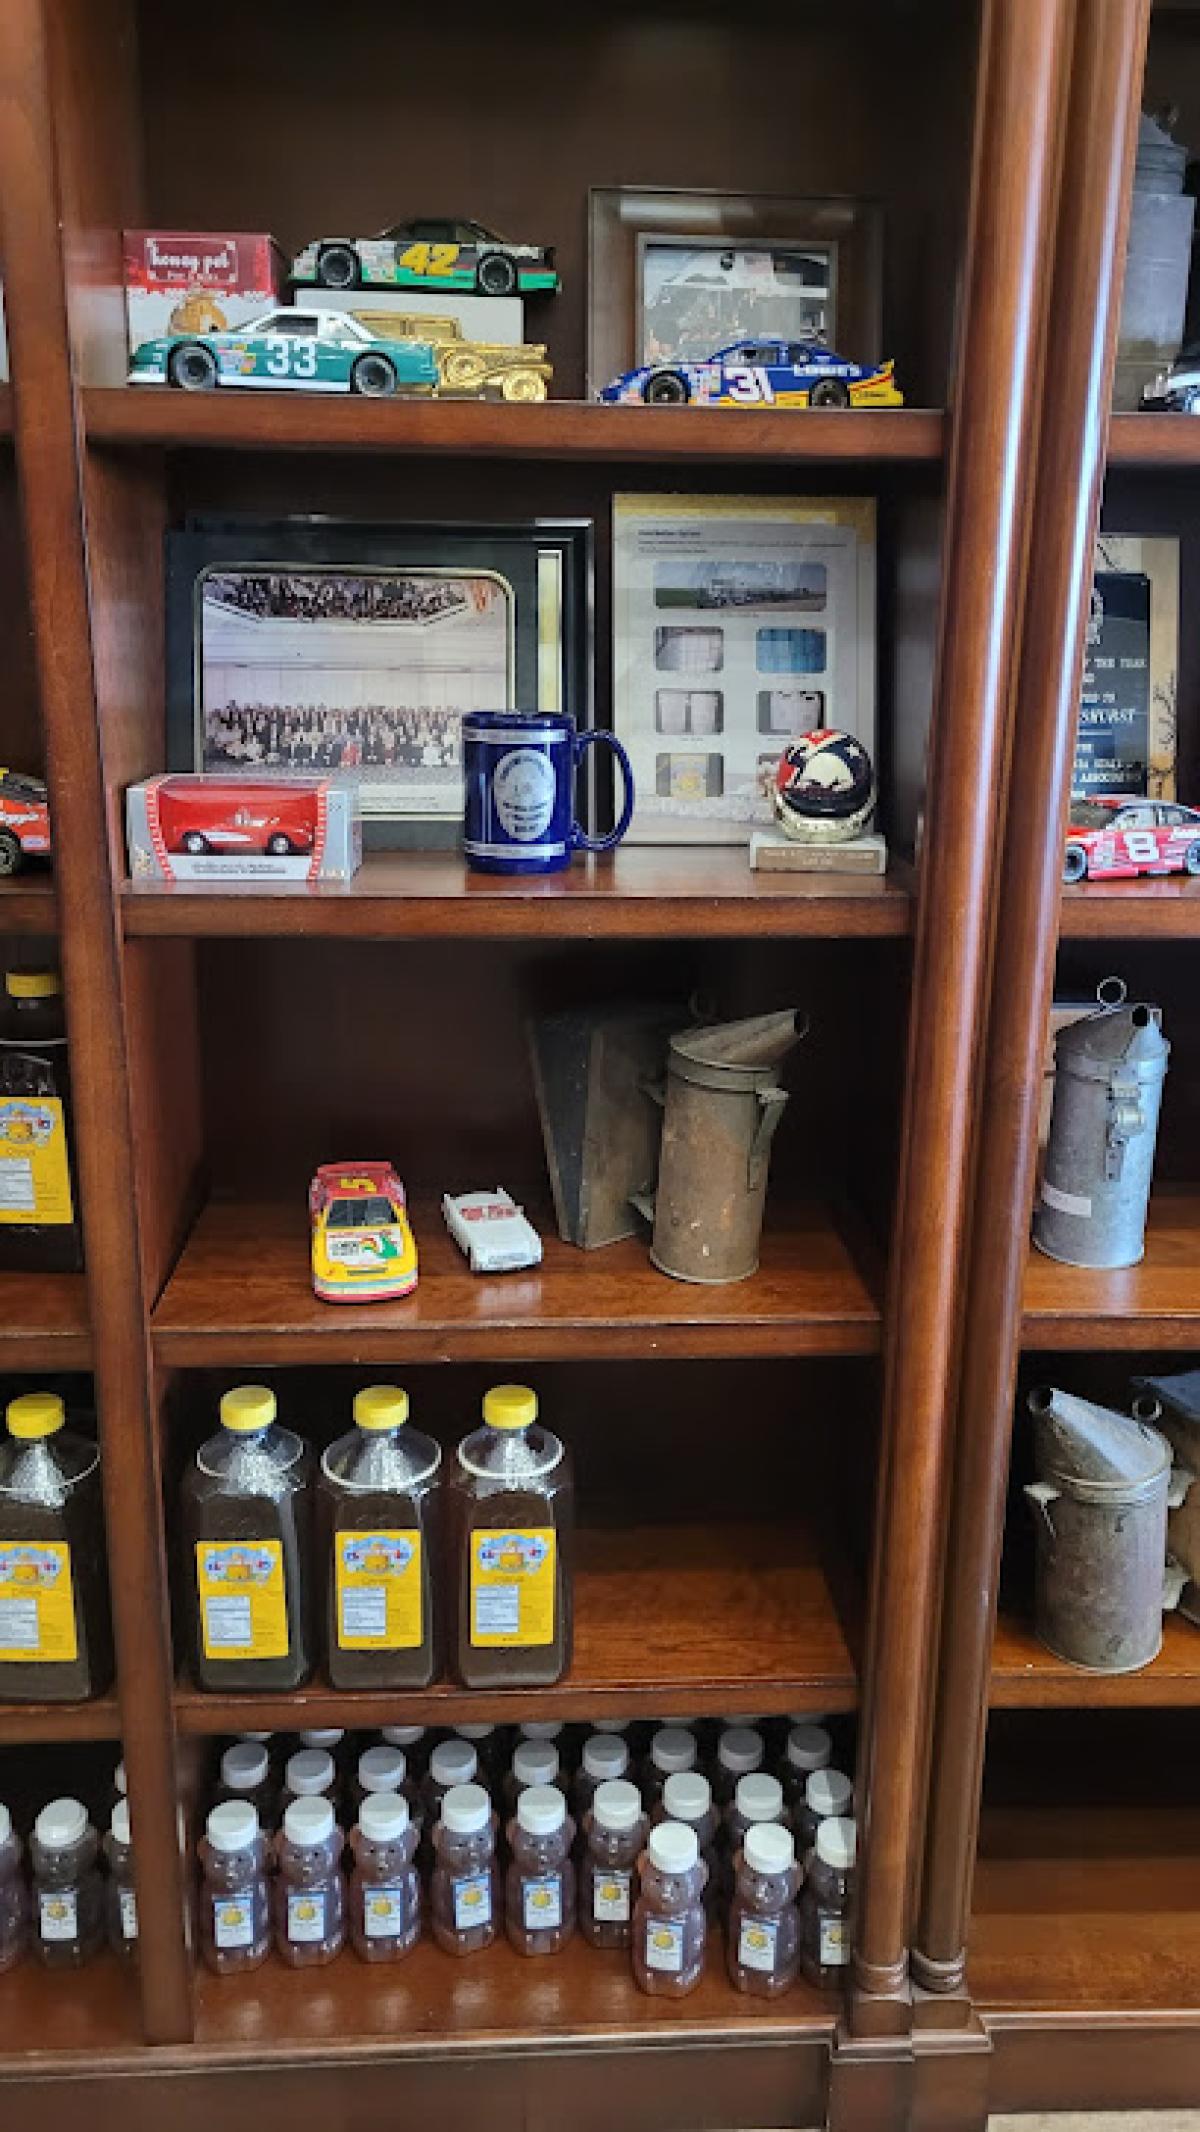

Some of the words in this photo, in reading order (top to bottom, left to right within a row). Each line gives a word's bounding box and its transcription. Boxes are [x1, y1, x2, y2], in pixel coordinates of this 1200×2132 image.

[399, 243, 459, 276] 42
[265, 338, 316, 376] 33
[722, 367, 775, 404] 31
[1123, 832, 1160, 863] 8
